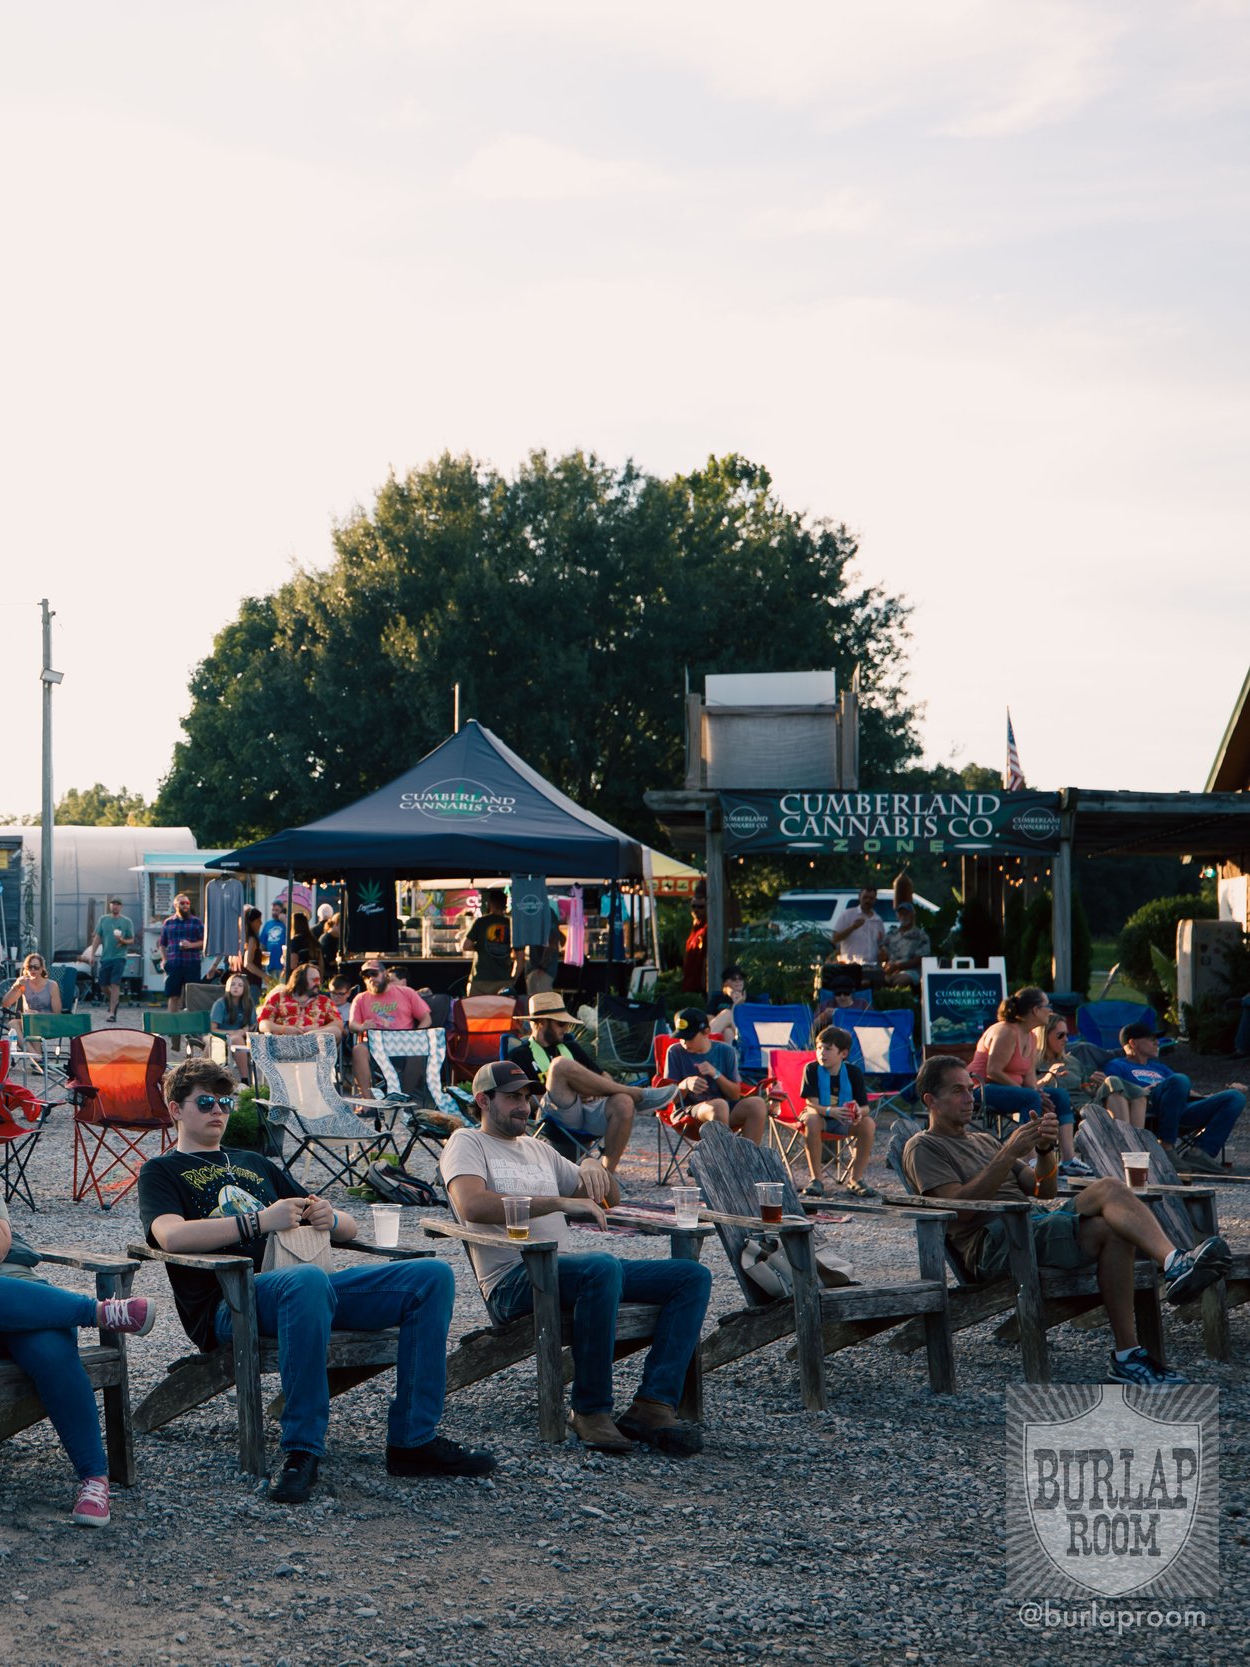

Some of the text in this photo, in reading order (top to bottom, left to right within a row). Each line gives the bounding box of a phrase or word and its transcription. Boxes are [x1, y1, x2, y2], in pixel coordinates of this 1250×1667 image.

[401, 792, 516, 805] CUMBERLAND
[779, 793, 1000, 816] CUMBERLAND
[399, 802, 517, 814] CANNABIS CO.
[780, 815, 1000, 839] CANNABIS CO.
[833, 838, 945, 852] ZONE
[935, 990, 997, 998] CUMBERLAND
